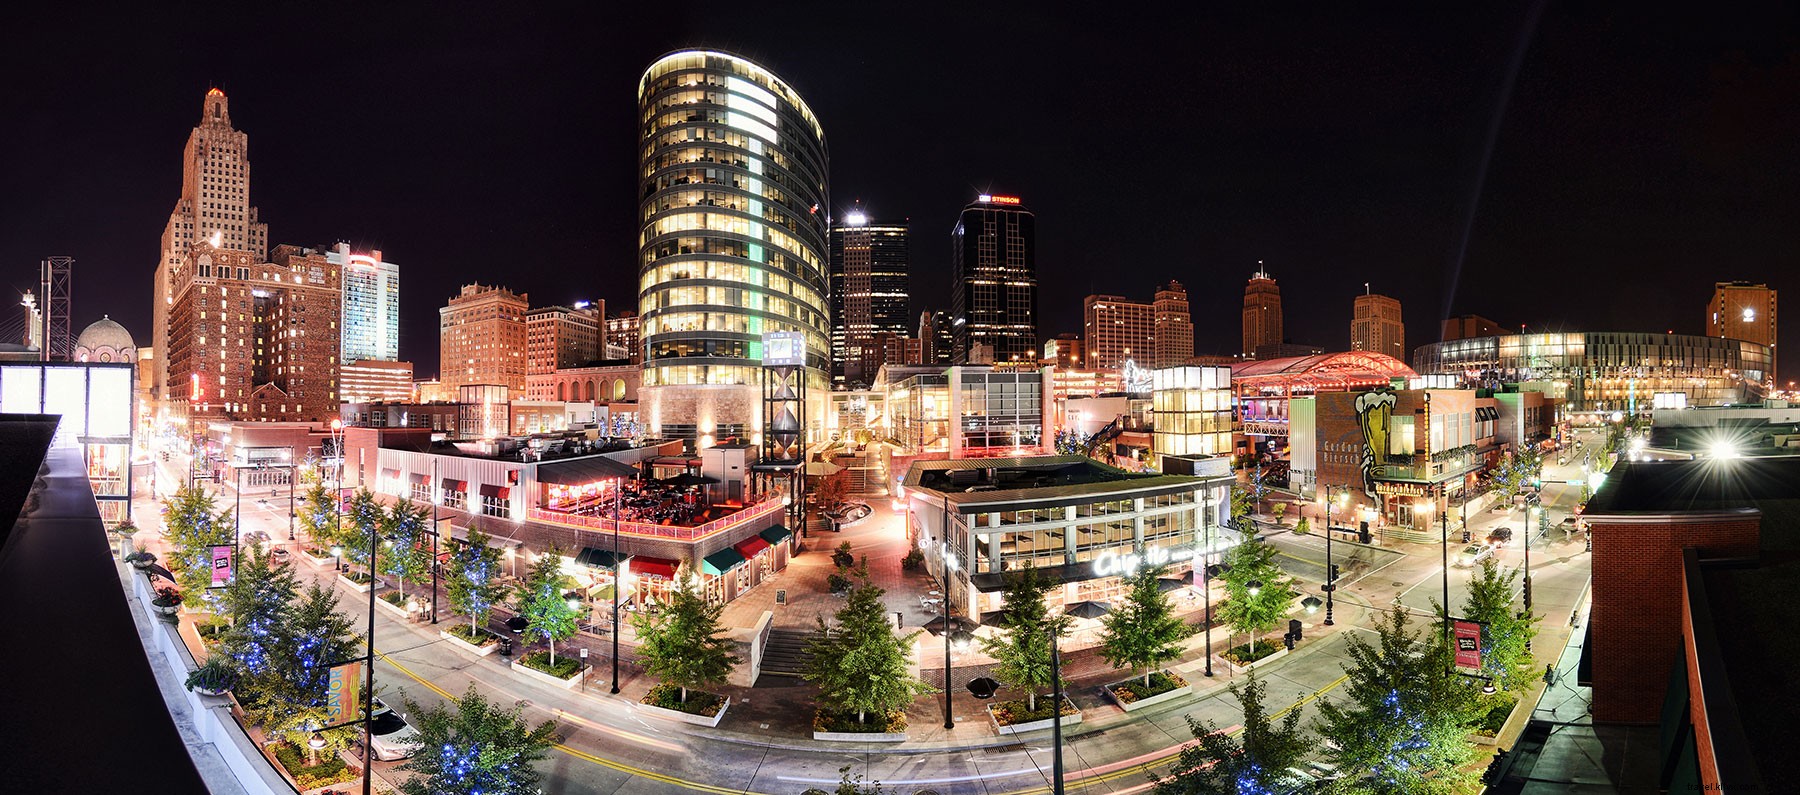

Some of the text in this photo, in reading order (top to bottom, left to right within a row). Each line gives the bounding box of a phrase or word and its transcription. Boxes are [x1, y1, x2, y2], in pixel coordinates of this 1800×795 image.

[992, 196, 1020, 204] STINSON
[1324, 441, 1357, 452] Gordon
[1323, 452, 1359, 464] Biersch
[328, 669, 342, 716] SAVOR
